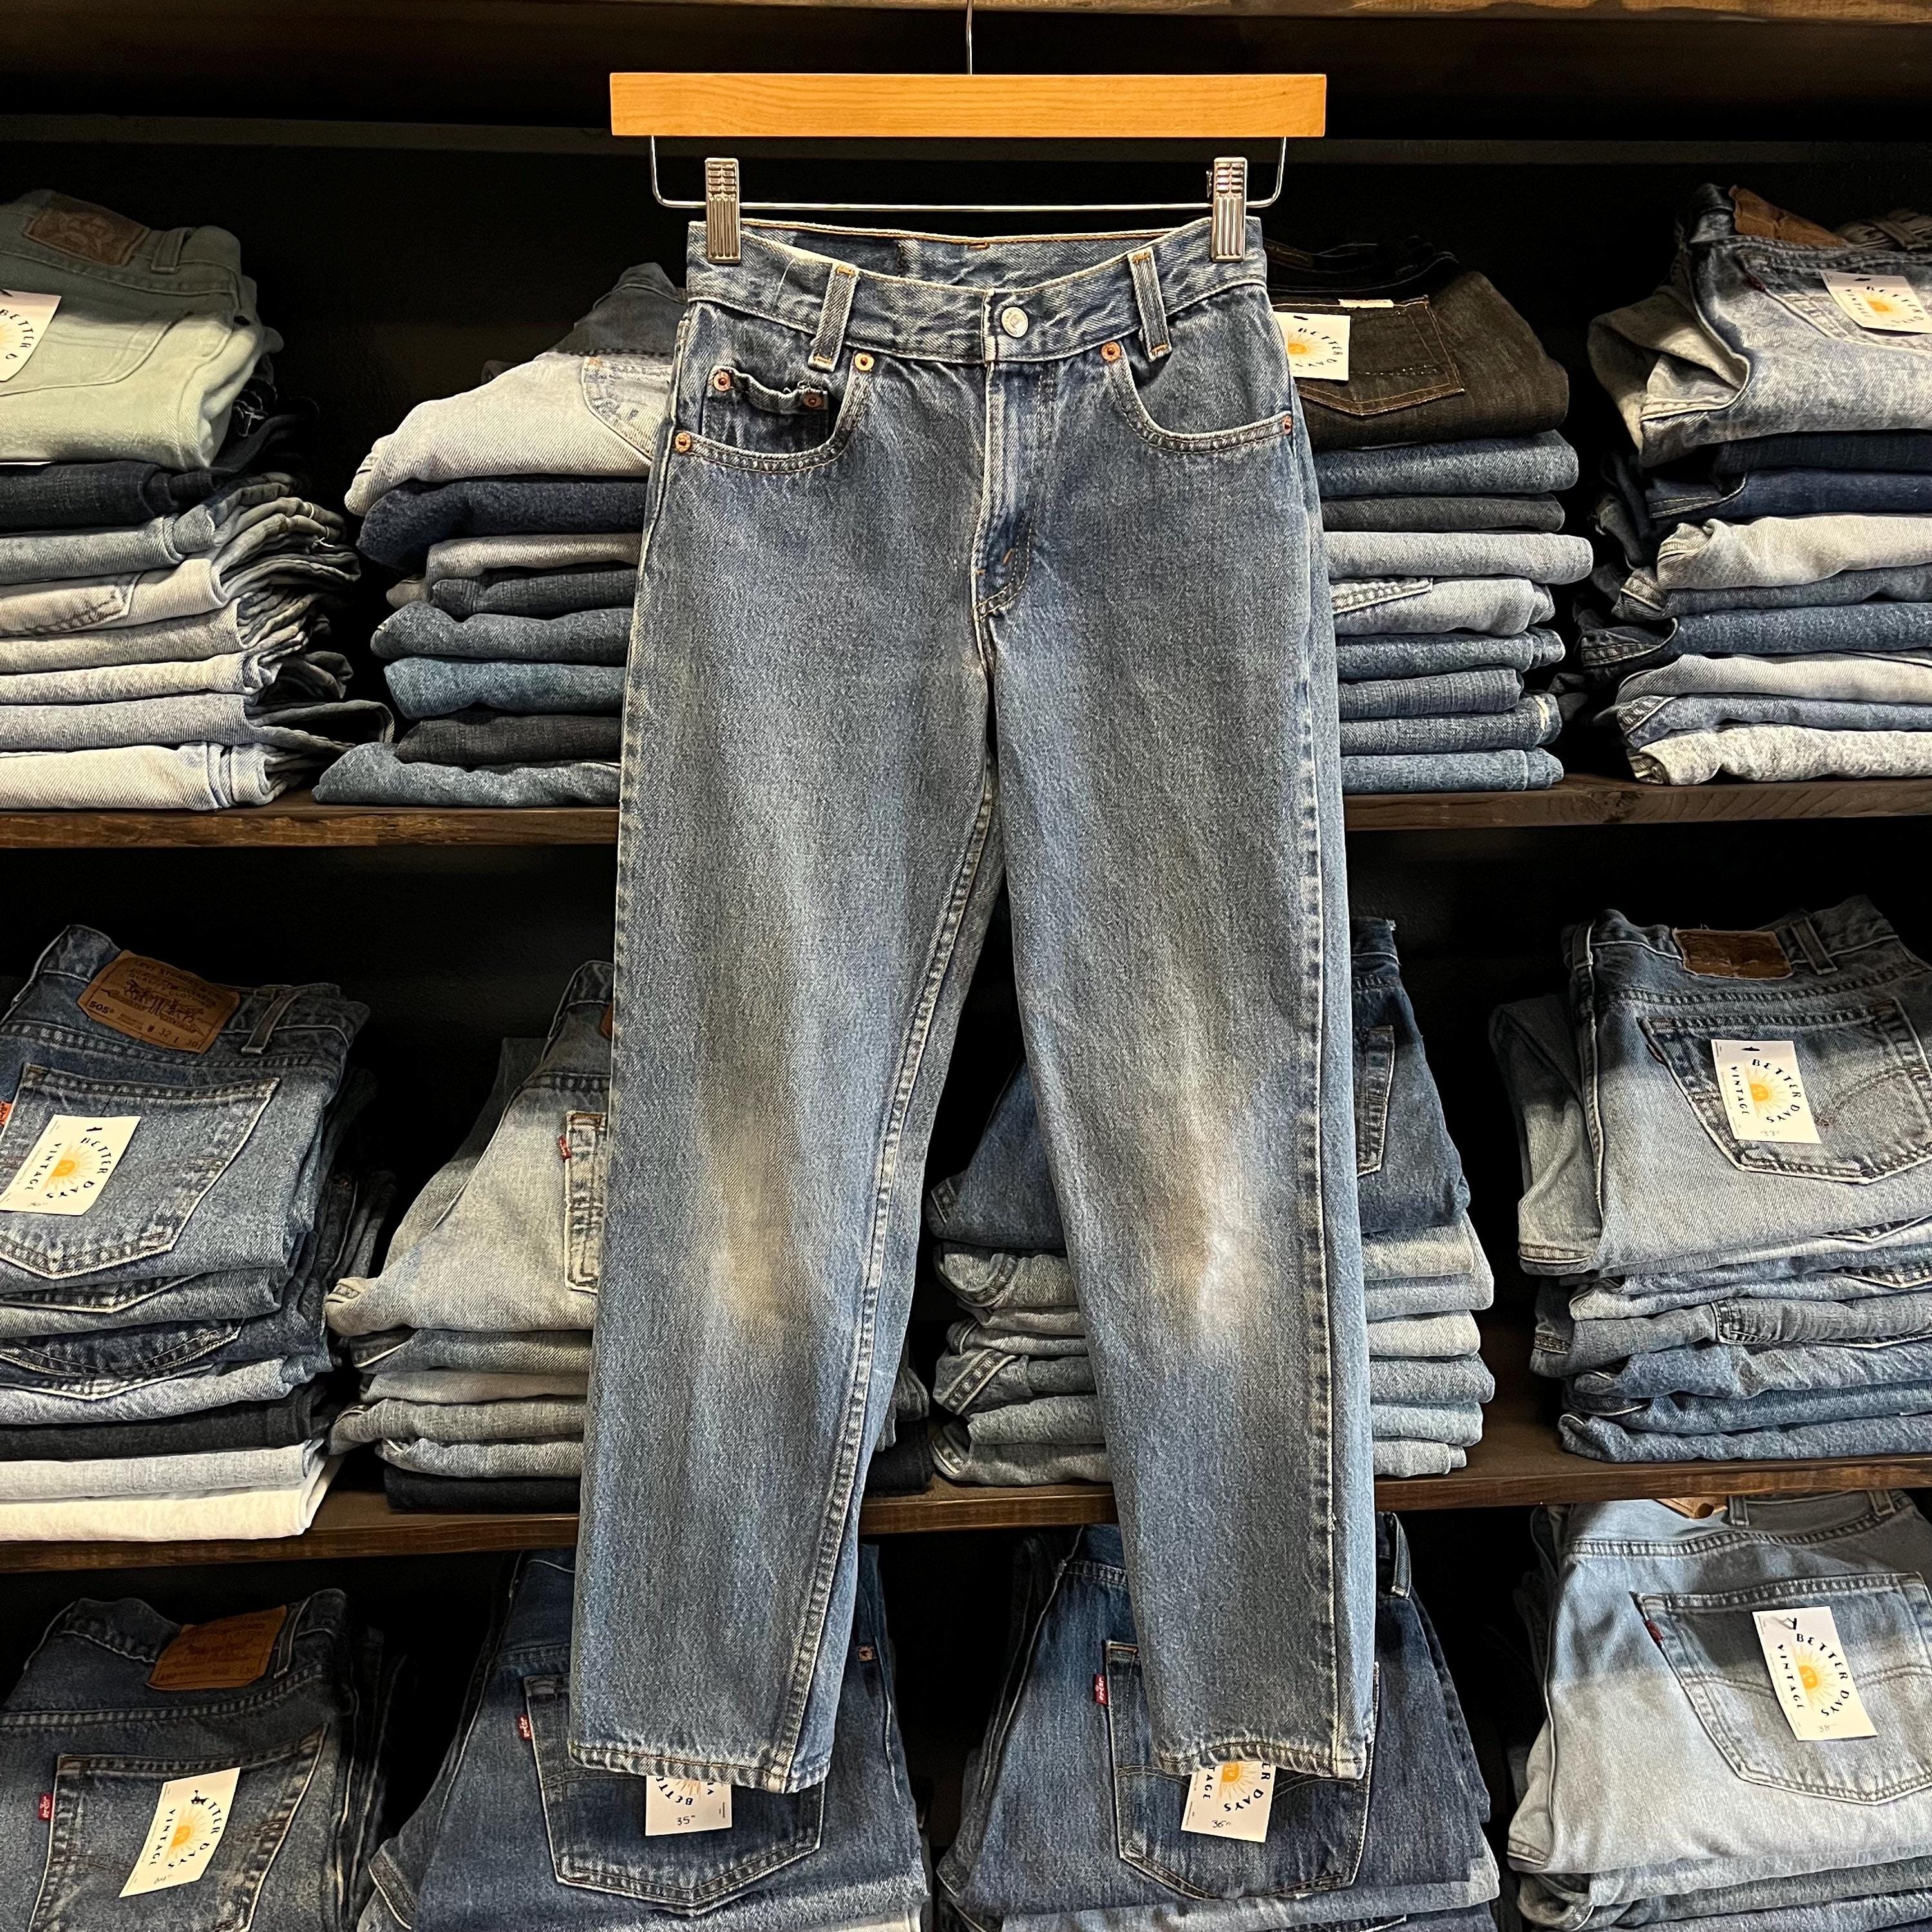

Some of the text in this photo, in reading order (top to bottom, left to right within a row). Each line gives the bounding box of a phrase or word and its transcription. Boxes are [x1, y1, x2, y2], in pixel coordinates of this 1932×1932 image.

[158, 1028, 171, 1038] 32
[1730, 1066, 1750, 1115] VINTAGE
[1752, 1059, 1801, 1122] BETTER DAYS
[24, 1143, 62, 1191] VINTAGE
[46, 1137, 111, 1198] BETTER DAYS
[1777, 1644, 1804, 1709] VINTAGE
[1797, 1633, 1850, 1716] BETTER DAYS
[1203, 1767, 1215, 1799] TAGE
[1224, 1788, 1264, 1812] DAYS
[149, 1809, 176, 1866] VINTAGE
[168, 1842, 211, 1868] DAYS
